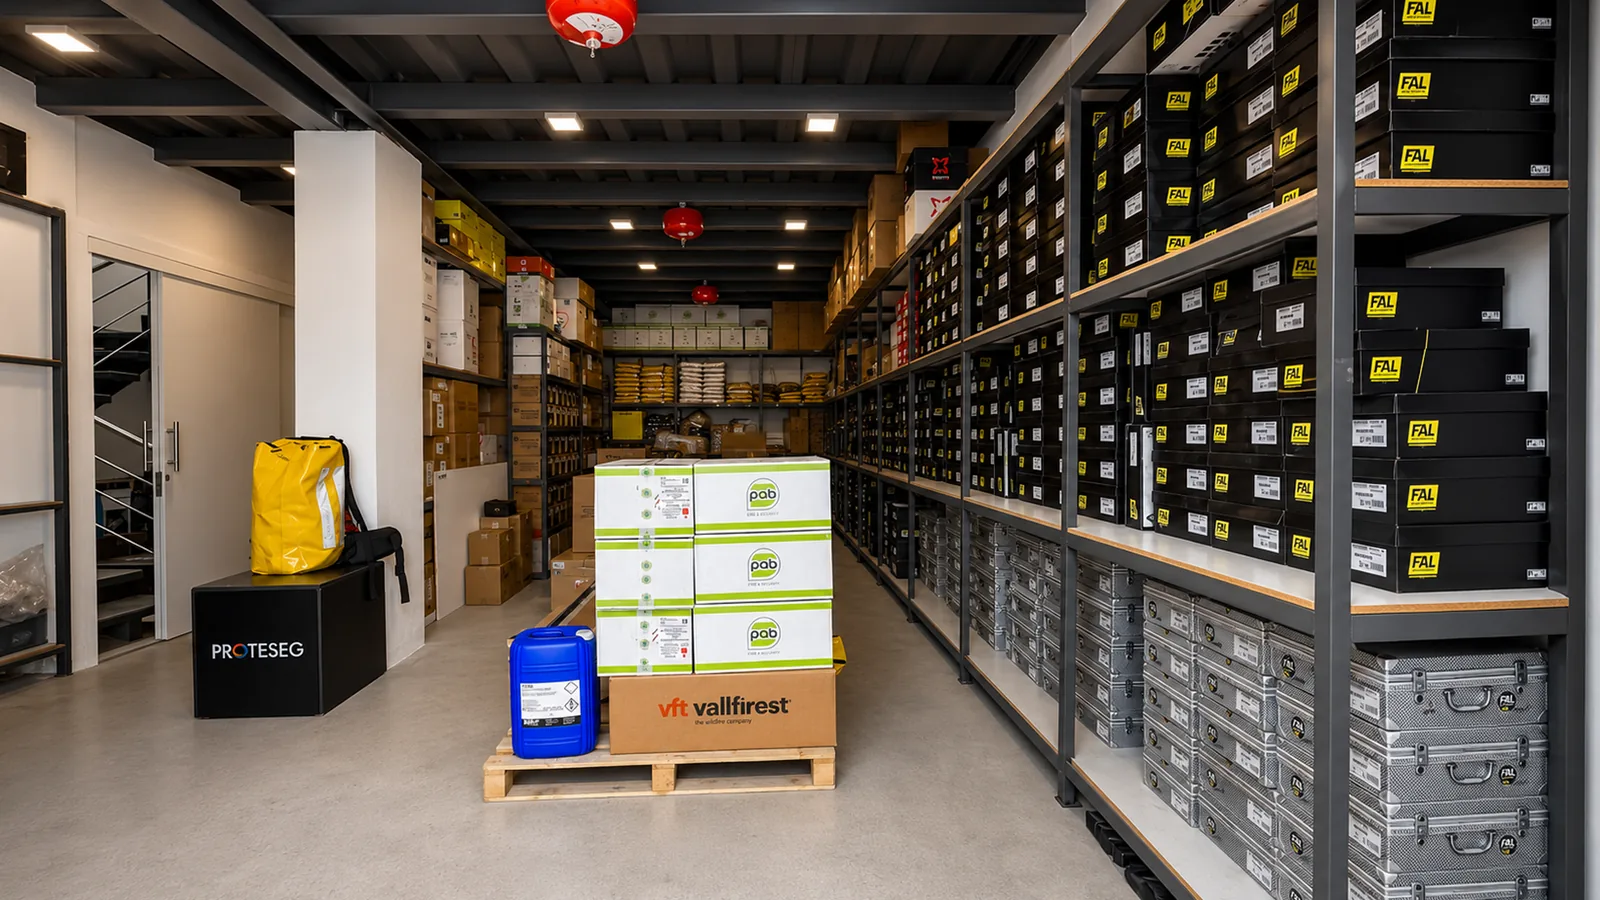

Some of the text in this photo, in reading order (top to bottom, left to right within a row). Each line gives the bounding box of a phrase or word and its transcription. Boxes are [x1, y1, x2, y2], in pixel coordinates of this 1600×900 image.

[1406, 1, 1432, 15] FAL
[1401, 76, 1427, 90] FAL
[1168, 94, 1187, 104] FAL
[1168, 141, 1187, 151] FAL
[1404, 149, 1430, 162] FAL
[1169, 188, 1188, 199] FAL
[1295, 260, 1317, 271] FAL
[1369, 295, 1395, 309] FAL
[1373, 360, 1398, 373] FAL
[1285, 367, 1301, 380] FAL
[1293, 425, 1308, 437] FAL
[1410, 423, 1435, 437] FAL
[1296, 482, 1312, 494] FAL
[1410, 488, 1434, 501] FAL
[749, 489, 777, 503] pab
[1293, 538, 1309, 551] FAL
[750, 558, 778, 572] pab
[1410, 556, 1435, 569] FAL
[750, 627, 778, 642] pab
[212, 642, 304, 659] PROTESEG
[658, 696, 789, 718] vft vallfirest
